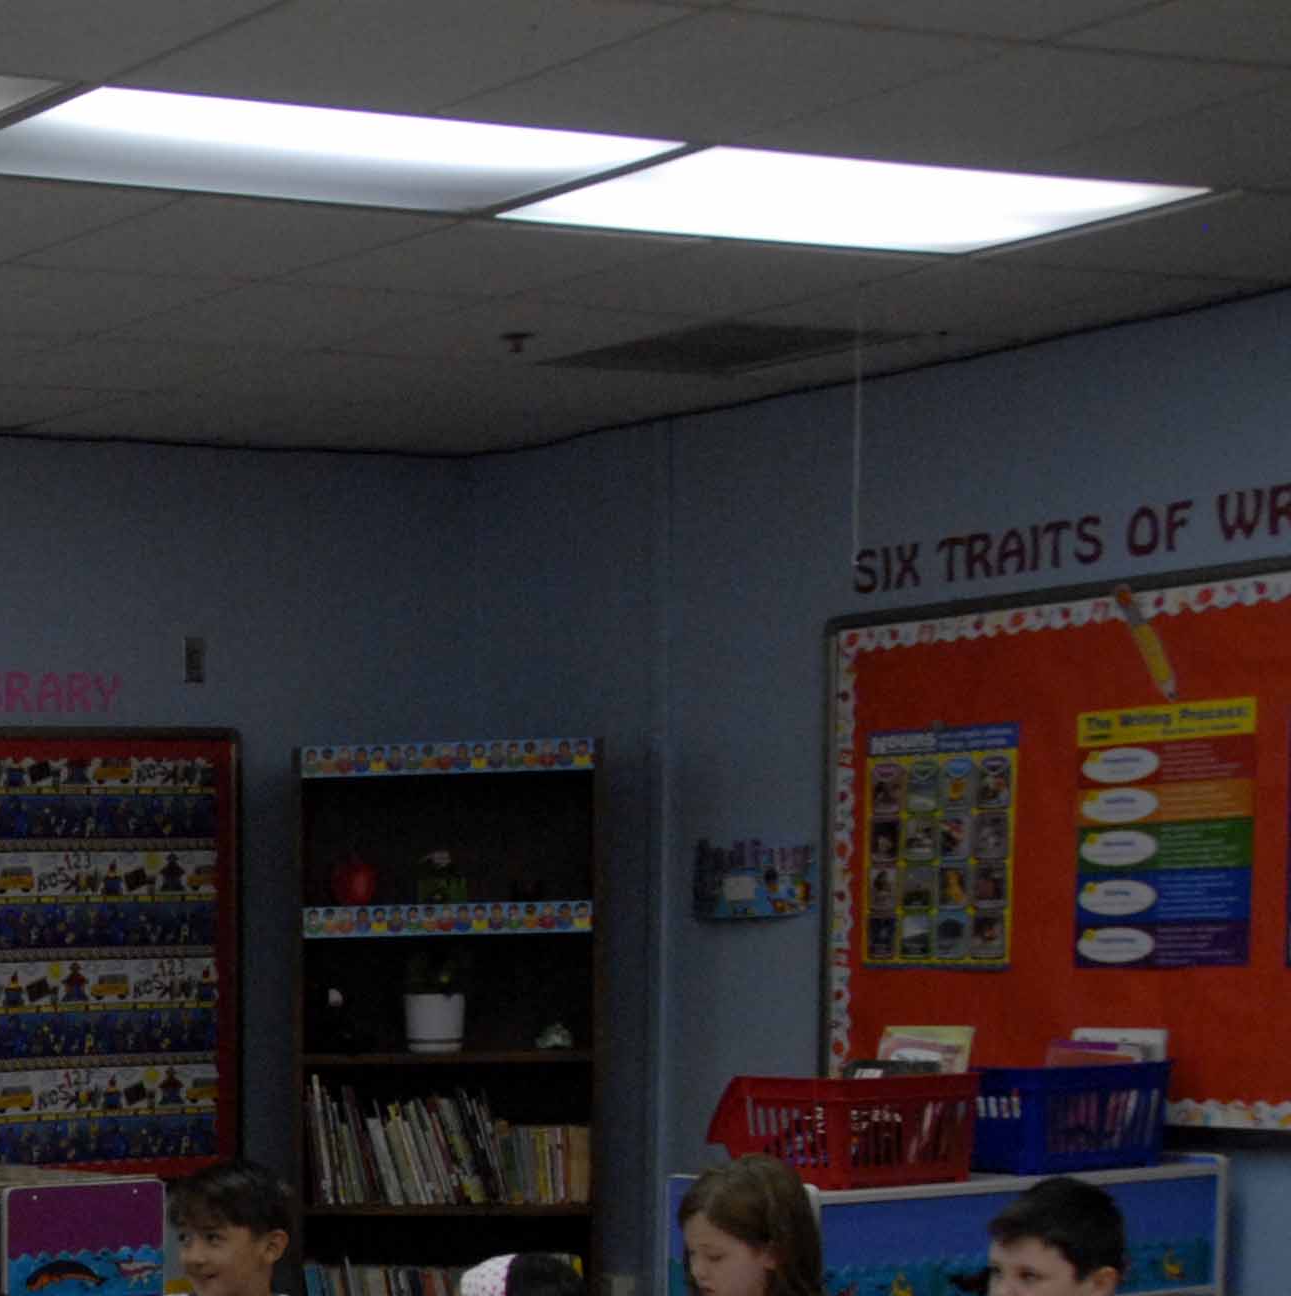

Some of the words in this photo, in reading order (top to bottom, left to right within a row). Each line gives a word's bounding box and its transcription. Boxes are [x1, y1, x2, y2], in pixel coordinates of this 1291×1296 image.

[853, 542, 921, 594] SIX
[937, 515, 1104, 583] TRAITS
[1127, 500, 1194, 557] OF
